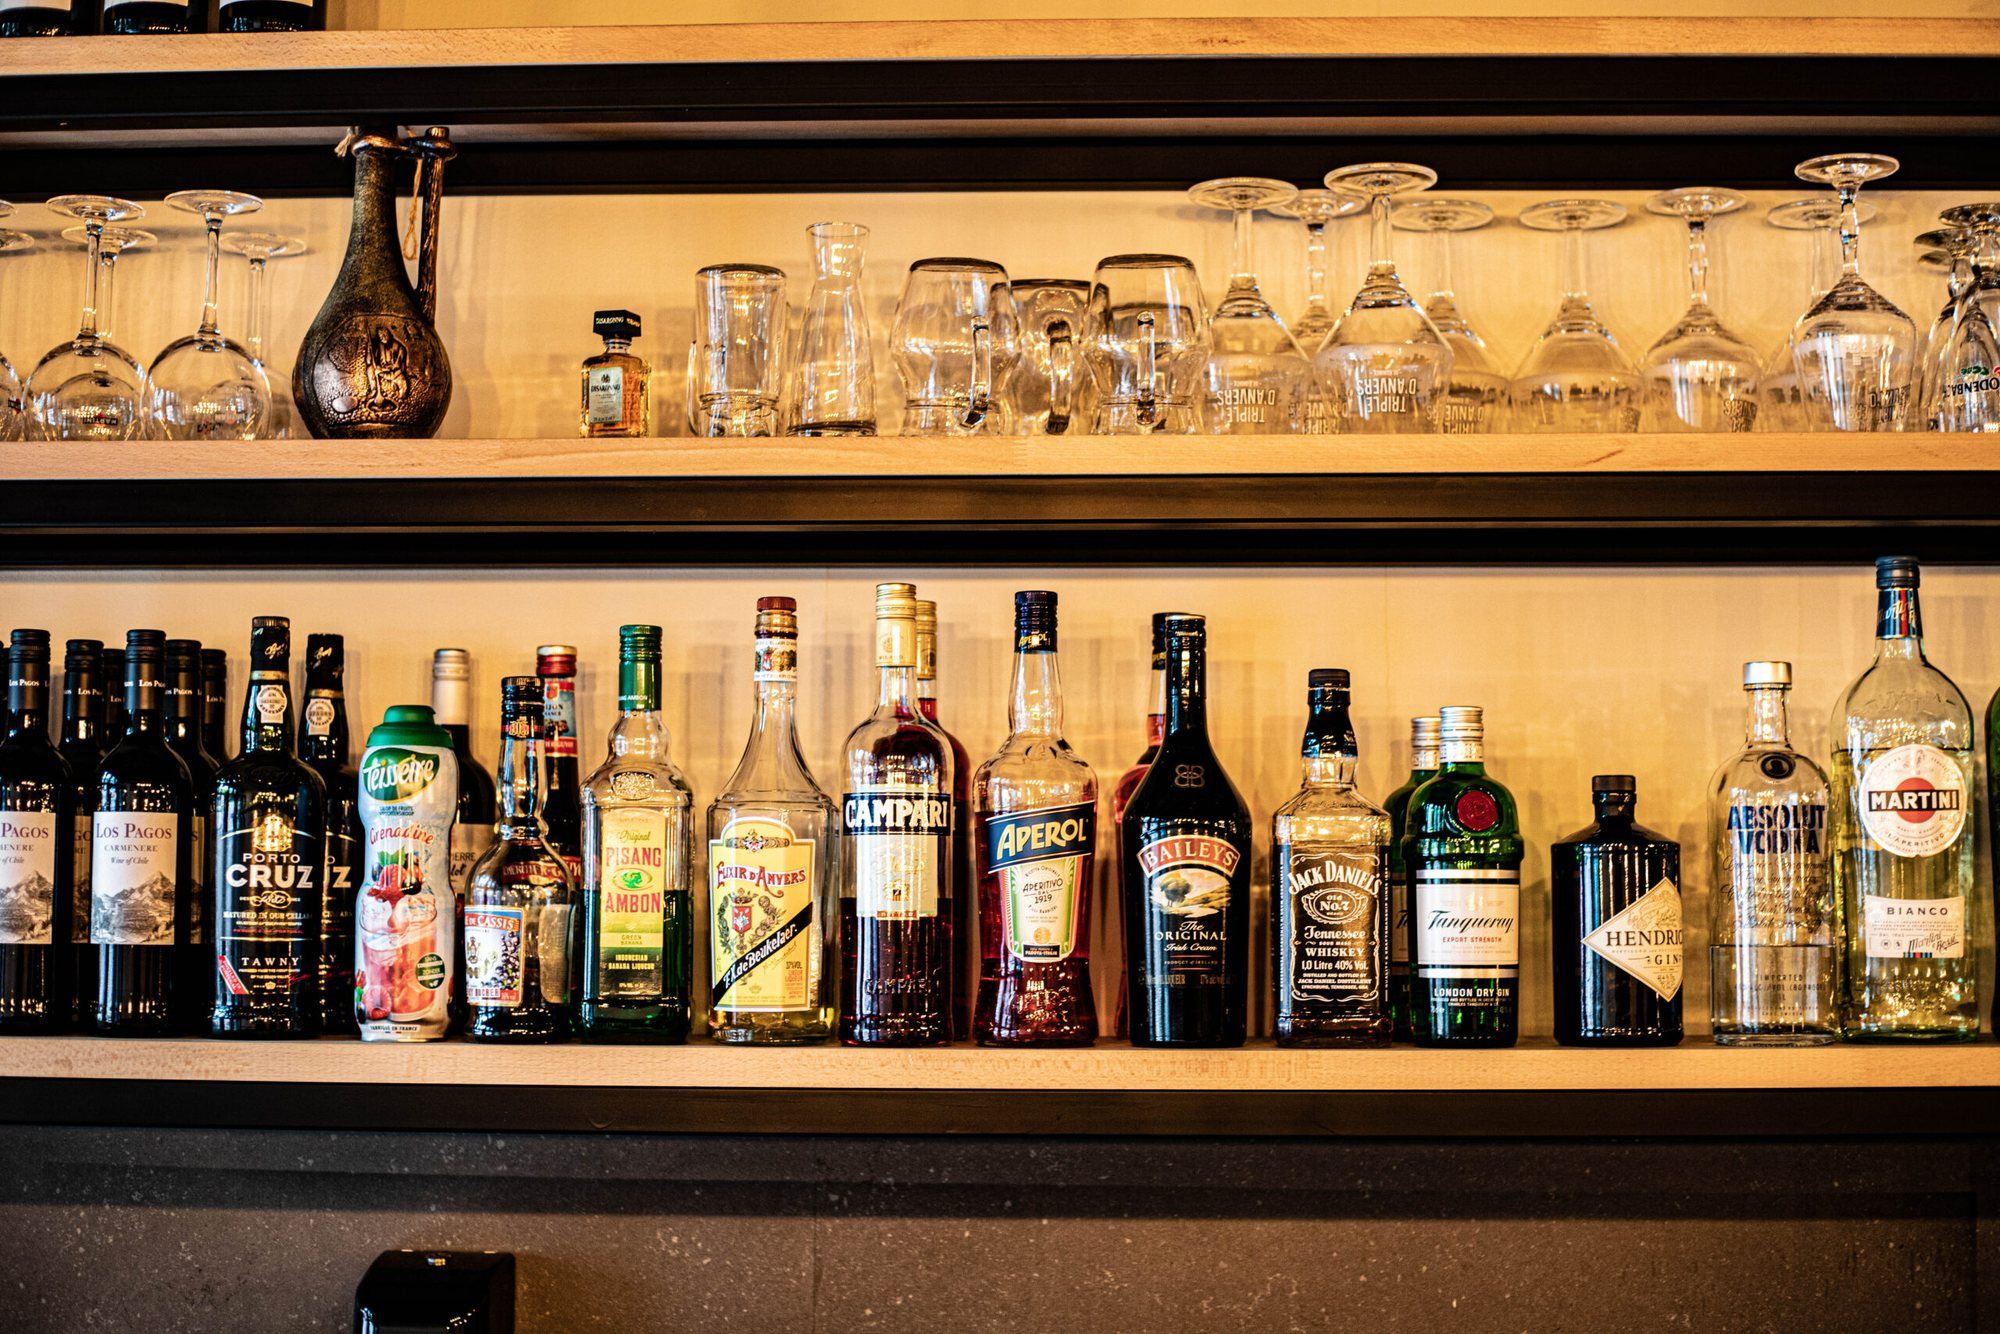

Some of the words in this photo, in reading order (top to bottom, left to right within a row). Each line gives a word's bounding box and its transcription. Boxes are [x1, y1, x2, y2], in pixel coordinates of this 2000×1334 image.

[1358, 378, 1417, 395] D'ANVERS
[1216, 388, 1276, 406] D'ANVERS
[1367, 395, 1407, 412] TRIPLE
[1225, 406, 1265, 423] TRIPLE
[362, 754, 435, 793] Teisseire
[1870, 790, 1958, 811] MARTINI
[845, 798, 948, 828] CAMPARI
[1726, 804, 1826, 830] ABSOLUT
[1, 822, 50, 838] PAGOS
[95, 822, 120, 839] LOS
[124, 822, 172, 840] PAGOS
[369, 823, 434, 845] Grenadine
[616, 829, 651, 844] Original
[996, 817, 1087, 861] APEROL
[1737, 830, 1820, 855] VODKA
[104, 843, 159, 853] CARMENERE
[1145, 839, 1235, 868] BAILEYS
[8, 856, 25, 864] Chile
[126, 856, 132, 866] of
[132, 856, 150, 864] Chile
[242, 853, 301, 863] PORTO
[605, 847, 662, 867] PISANG
[225, 863, 314, 889] CRUZ
[716, 860, 747, 889] ELIXIR
[1287, 864, 1323, 895] JACK
[1325, 859, 1383, 896] DANIEL'S
[1022, 877, 1064, 893] APERITIVO
[604, 891, 661, 913] AMBON
[1034, 893, 1053, 904] 1919
[1319, 900, 1350, 911] No.7
[1886, 907, 1949, 916] BIANCO
[468, 916, 477, 925] DE
[477, 914, 514, 930] CASSIS
[1178, 920, 1206, 931] The
[1427, 909, 1514, 934] Tanqueray
[1153, 931, 1228, 941] ORIGINAL
[1303, 925, 1367, 940] Tennessee
[1163, 942, 1188, 952] Irish
[1189, 942, 1218, 952] Cream
[1305, 947, 1365, 957] WHISKEY
[241, 957, 300, 967] TAWNY
[608, 962, 631, 970] BANANA
[1314, 959, 1334, 970] Litre
[1335, 959, 1353, 970] 40%
[1354, 959, 1370, 970] Vol.
[1434, 988, 1474, 997] LONDON
[1476, 988, 1495, 997] DRY
[1497, 988, 1510, 997] GIN
